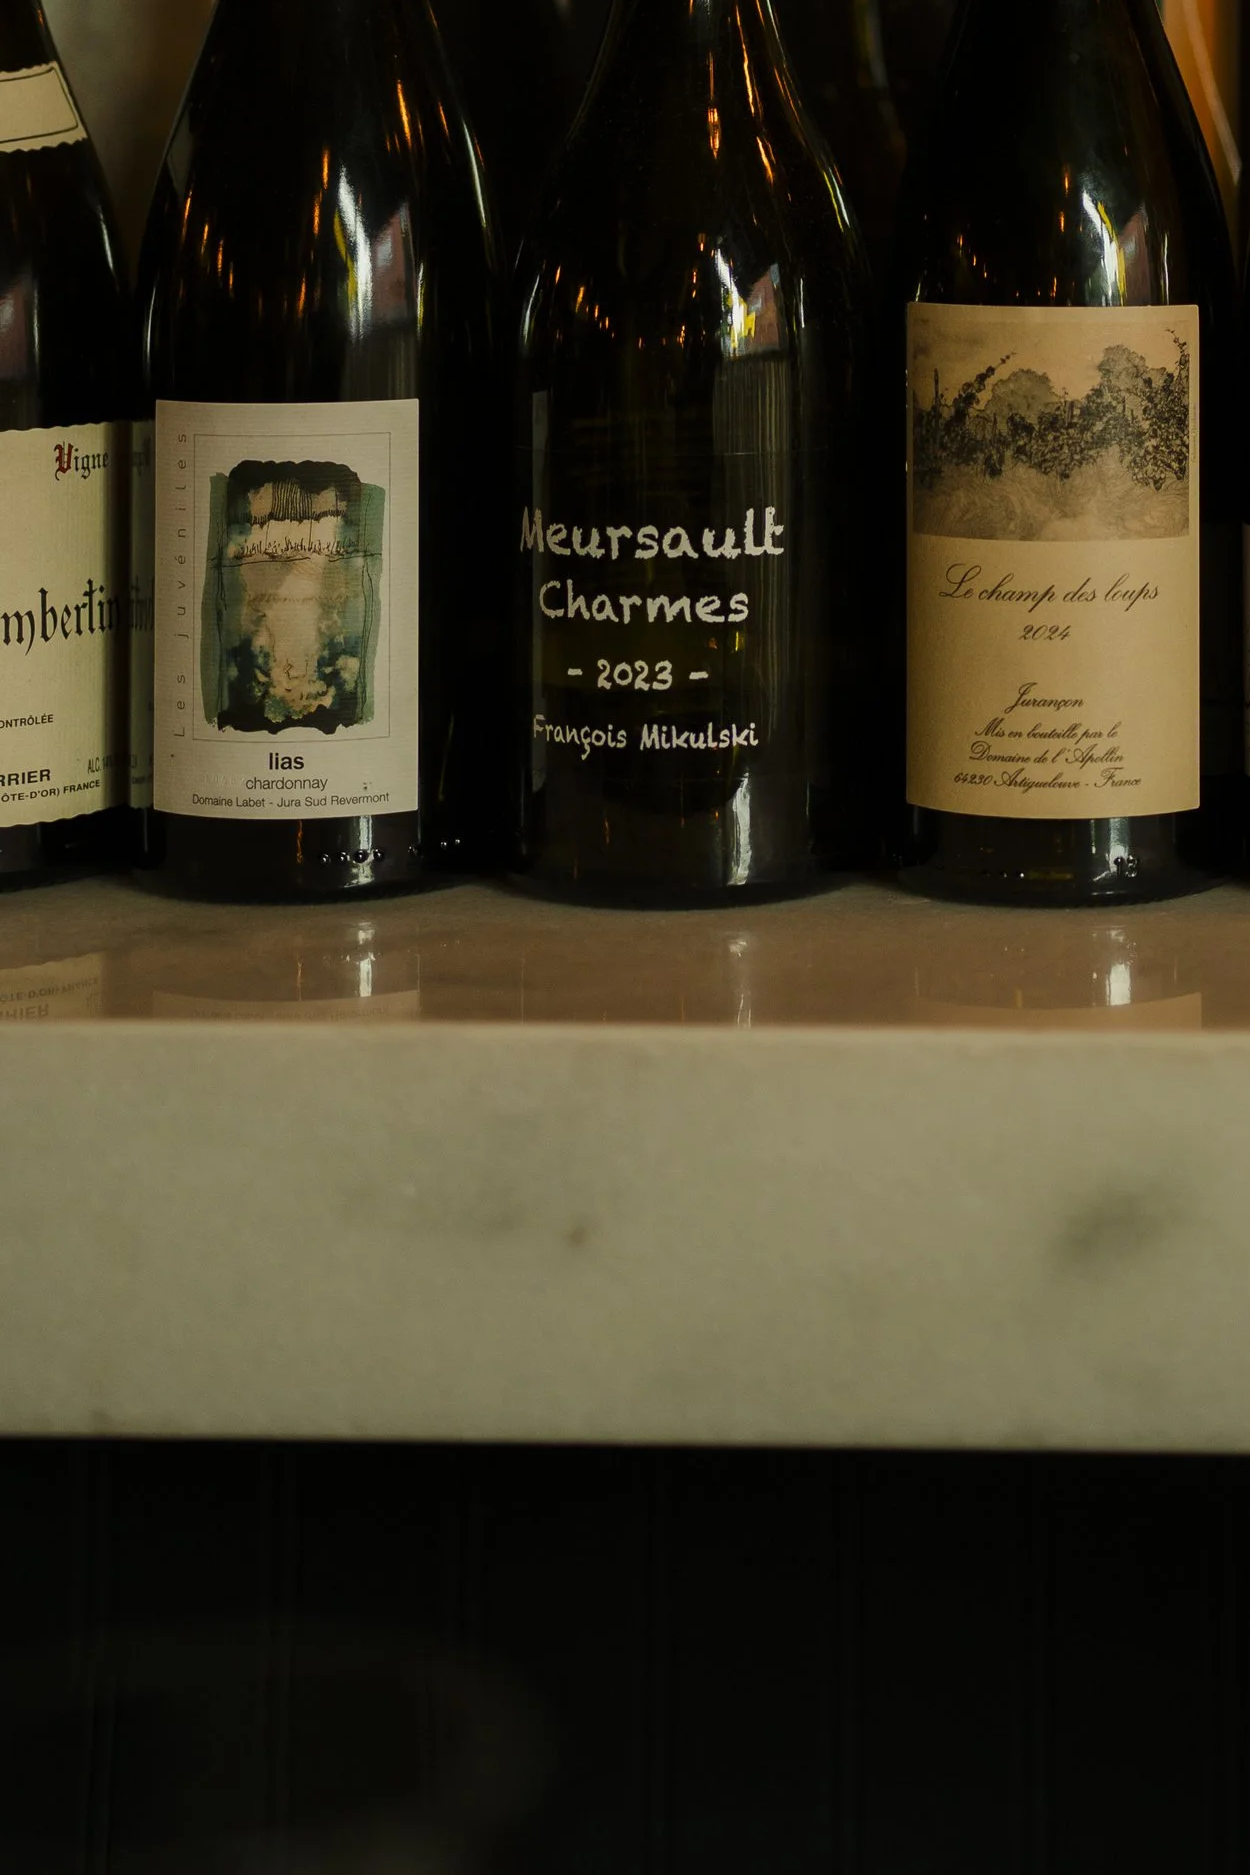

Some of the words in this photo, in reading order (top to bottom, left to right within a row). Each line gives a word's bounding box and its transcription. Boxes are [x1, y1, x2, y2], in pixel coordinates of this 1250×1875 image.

[174, 433, 189, 639] juvéniles
[520, 506, 785, 559] Meursault
[539, 579, 749, 624] Charmes
[939, 563, 982, 600] Le
[978, 573, 1056, 613] champ
[1063, 577, 1096, 602] des
[1104, 573, 1159, 612] loups
[1018, 624, 1072, 641] 2024
[597, 659, 673, 691] 2023
[174, 675, 185, 737] Les
[1004, 682, 1084, 714] Jurançon
[533, 715, 628, 760] François
[639, 722, 759, 751] Mikulski
[975, 717, 1006, 739] Mis
[1008, 729, 1024, 739] en
[1026, 722, 1082, 740] bouteille
[1075, 728, 1103, 746] par
[1107, 721, 1122, 739] le
[268, 752, 305, 771] lias
[968, 741, 1032, 763] Domaine
[1033, 749, 1049, 764] de
[62, 778, 102, 795] FRANCE
[245, 776, 329, 792] chardonnay
[953, 772, 994, 786] 64230
[1094, 767, 1143, 789] France
[192, 793, 233, 807] Domaine
[235, 796, 266, 808] Labet
[277, 797, 301, 808] Jura
[304, 796, 328, 807] Sud
[330, 792, 390, 806] Revermont
